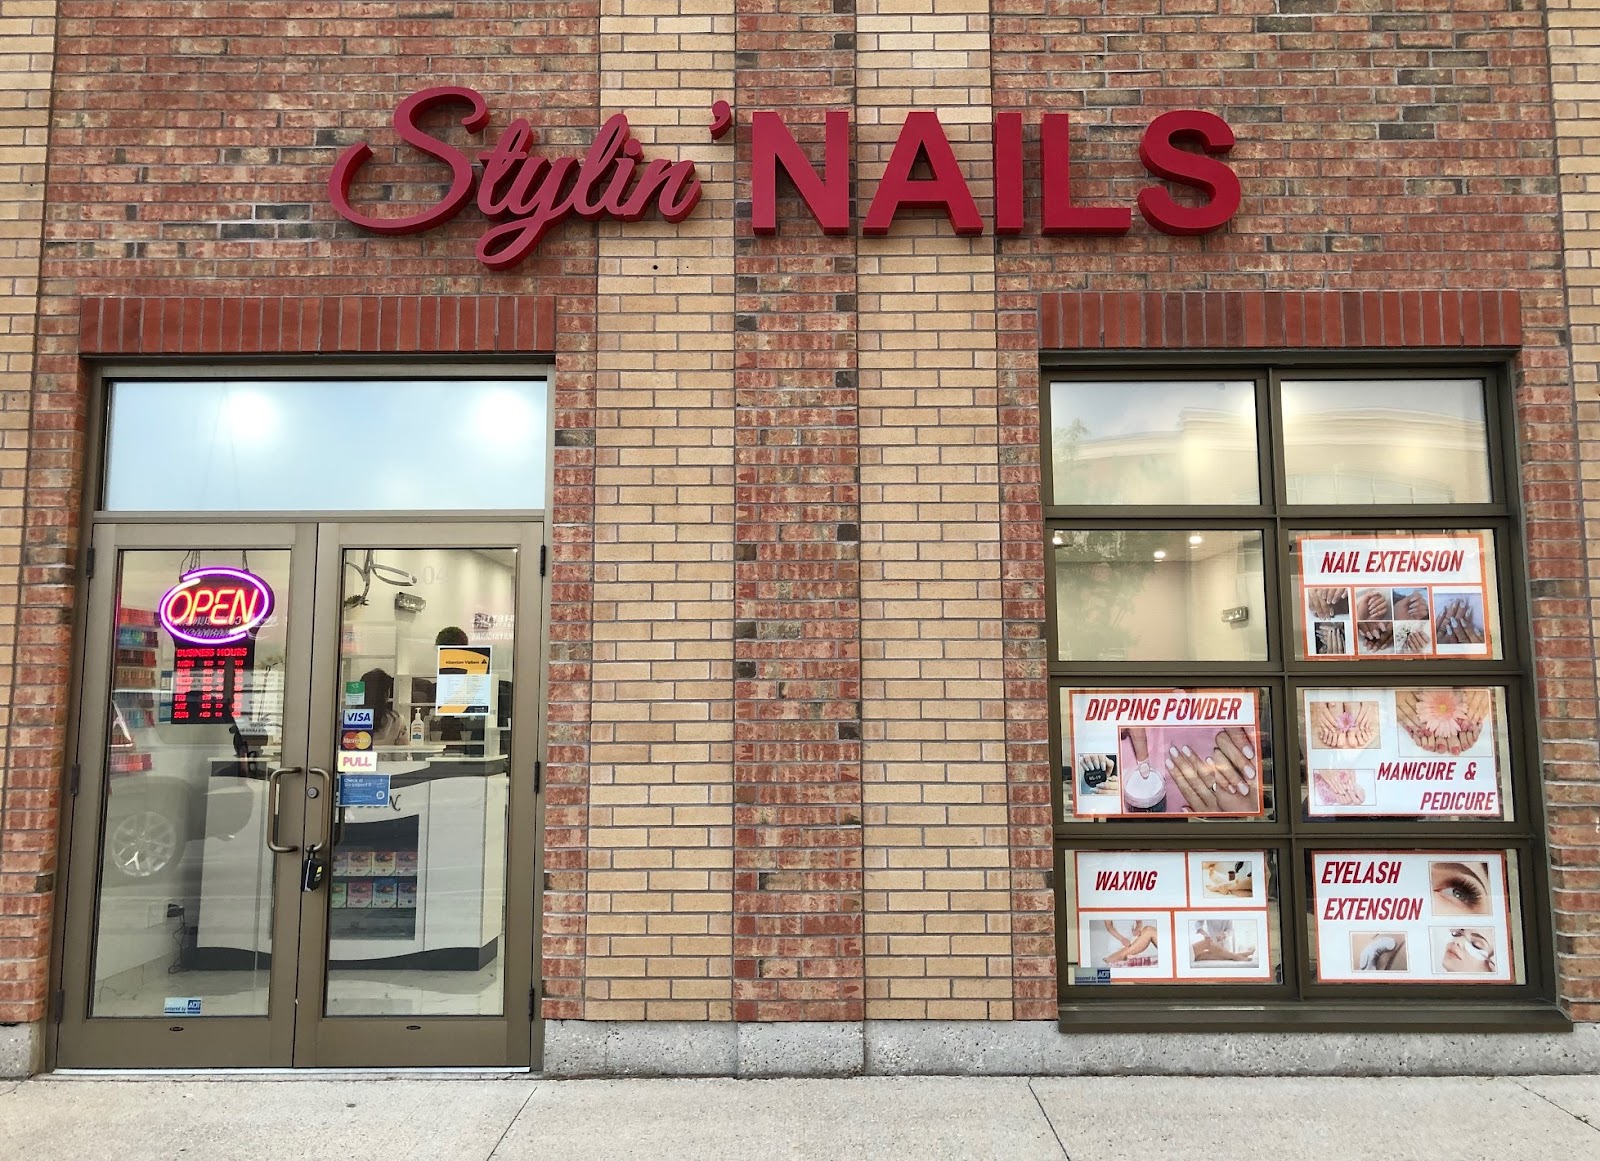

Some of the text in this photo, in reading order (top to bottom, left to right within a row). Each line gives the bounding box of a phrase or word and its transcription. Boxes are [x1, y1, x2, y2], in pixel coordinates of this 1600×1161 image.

[752, 109, 1242, 237] NAILS
[1321, 550, 1465, 574] NAIL EXTENSION
[167, 589, 258, 625] OPEN
[177, 647, 248, 657] BUSINESS HOURS
[174, 711, 189, 719] SUN
[347, 712, 371, 722] VISA
[1085, 696, 1243, 721] DIPPING POWDER
[342, 756, 372, 767] PULL
[1377, 760, 1477, 781] MANICURE &
[1420, 791, 1498, 811] PEDICURE
[1095, 870, 1158, 892] WAXING
[1321, 860, 1402, 884] EYELASH
[1322, 897, 1424, 921] EXTENSION
